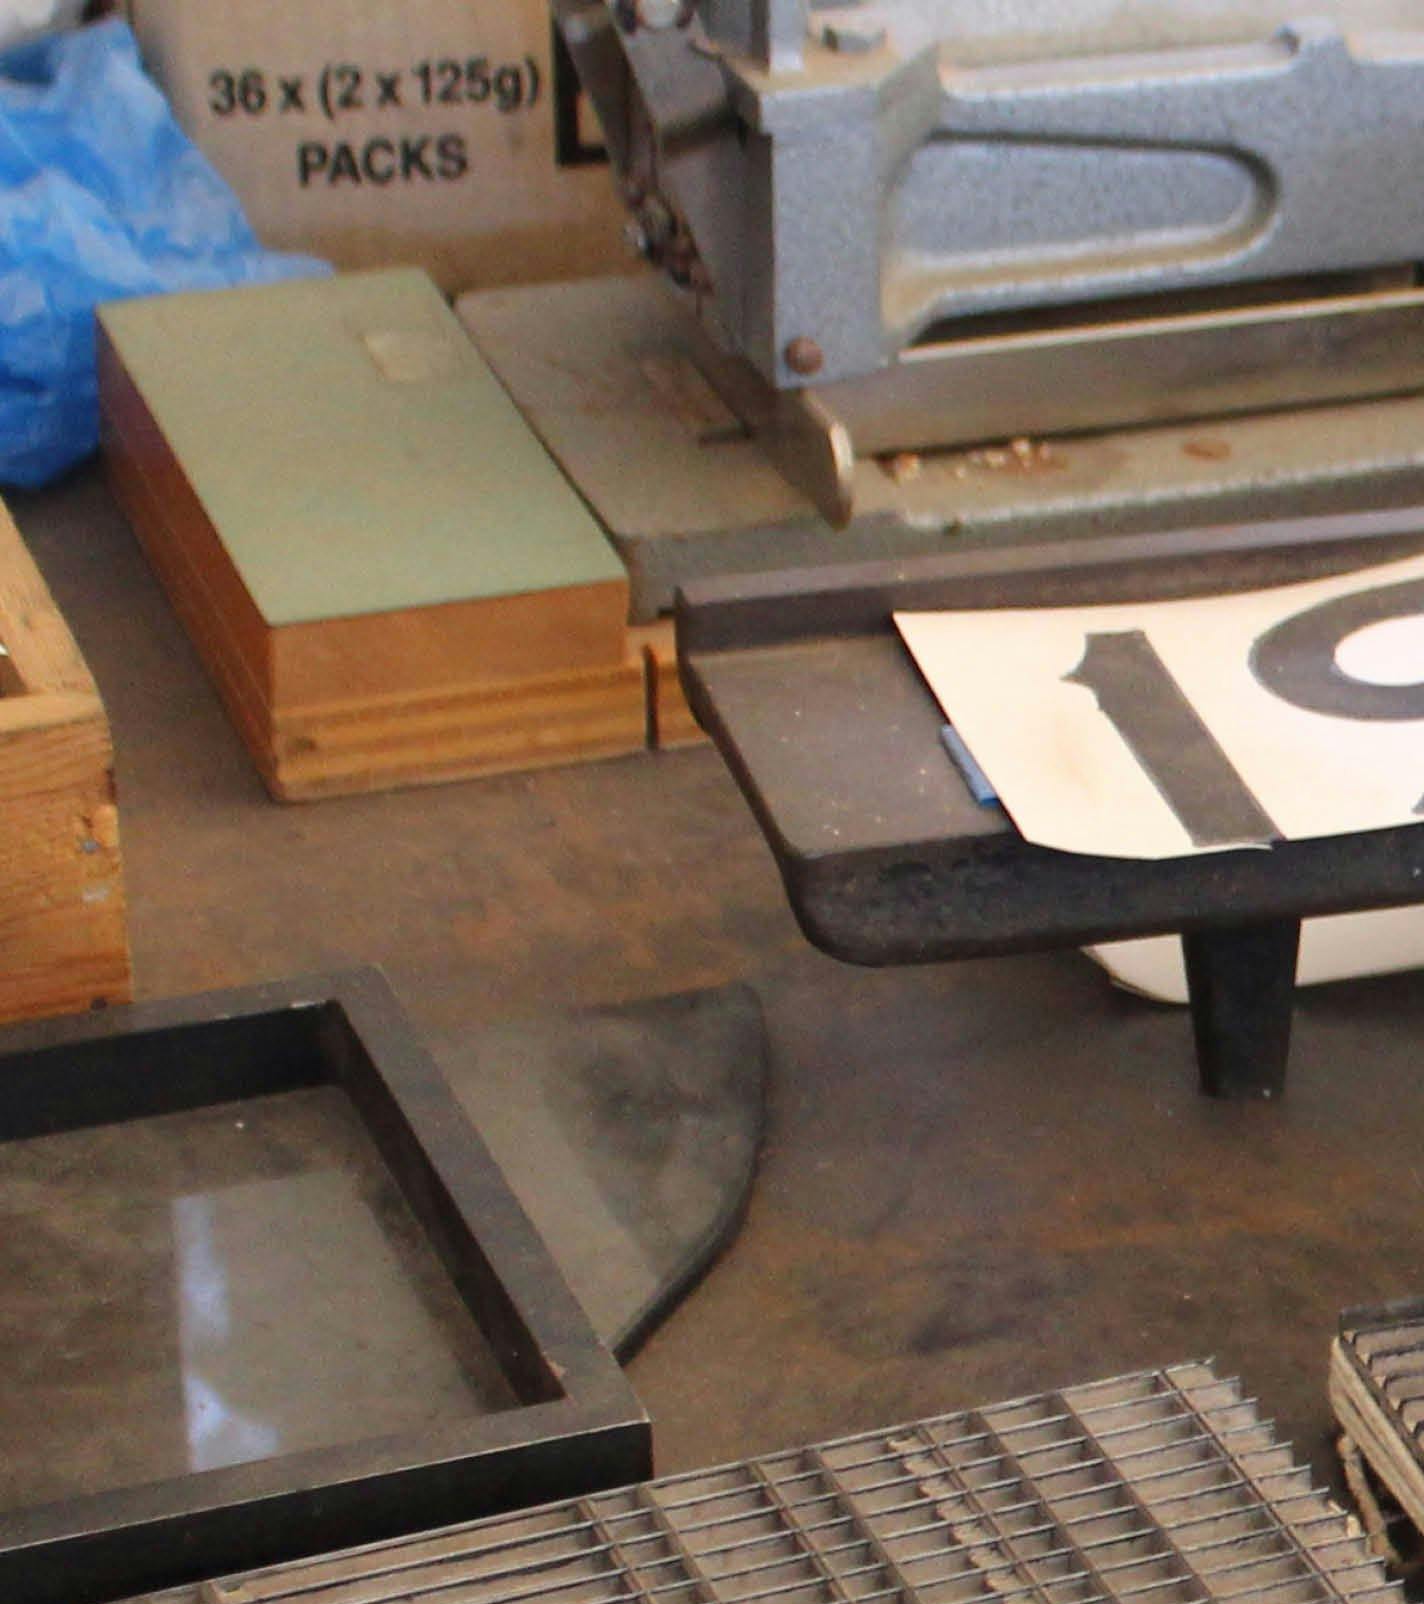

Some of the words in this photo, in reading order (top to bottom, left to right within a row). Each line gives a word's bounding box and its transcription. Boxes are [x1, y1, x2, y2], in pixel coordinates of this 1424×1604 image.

[208, 66, 266, 117] 36
[278, 77, 305, 113] x
[318, 63, 363, 119] (2
[376, 71, 402, 107] x
[411, 56, 541, 113] 125g)
[297, 133, 469, 187] PACKS
